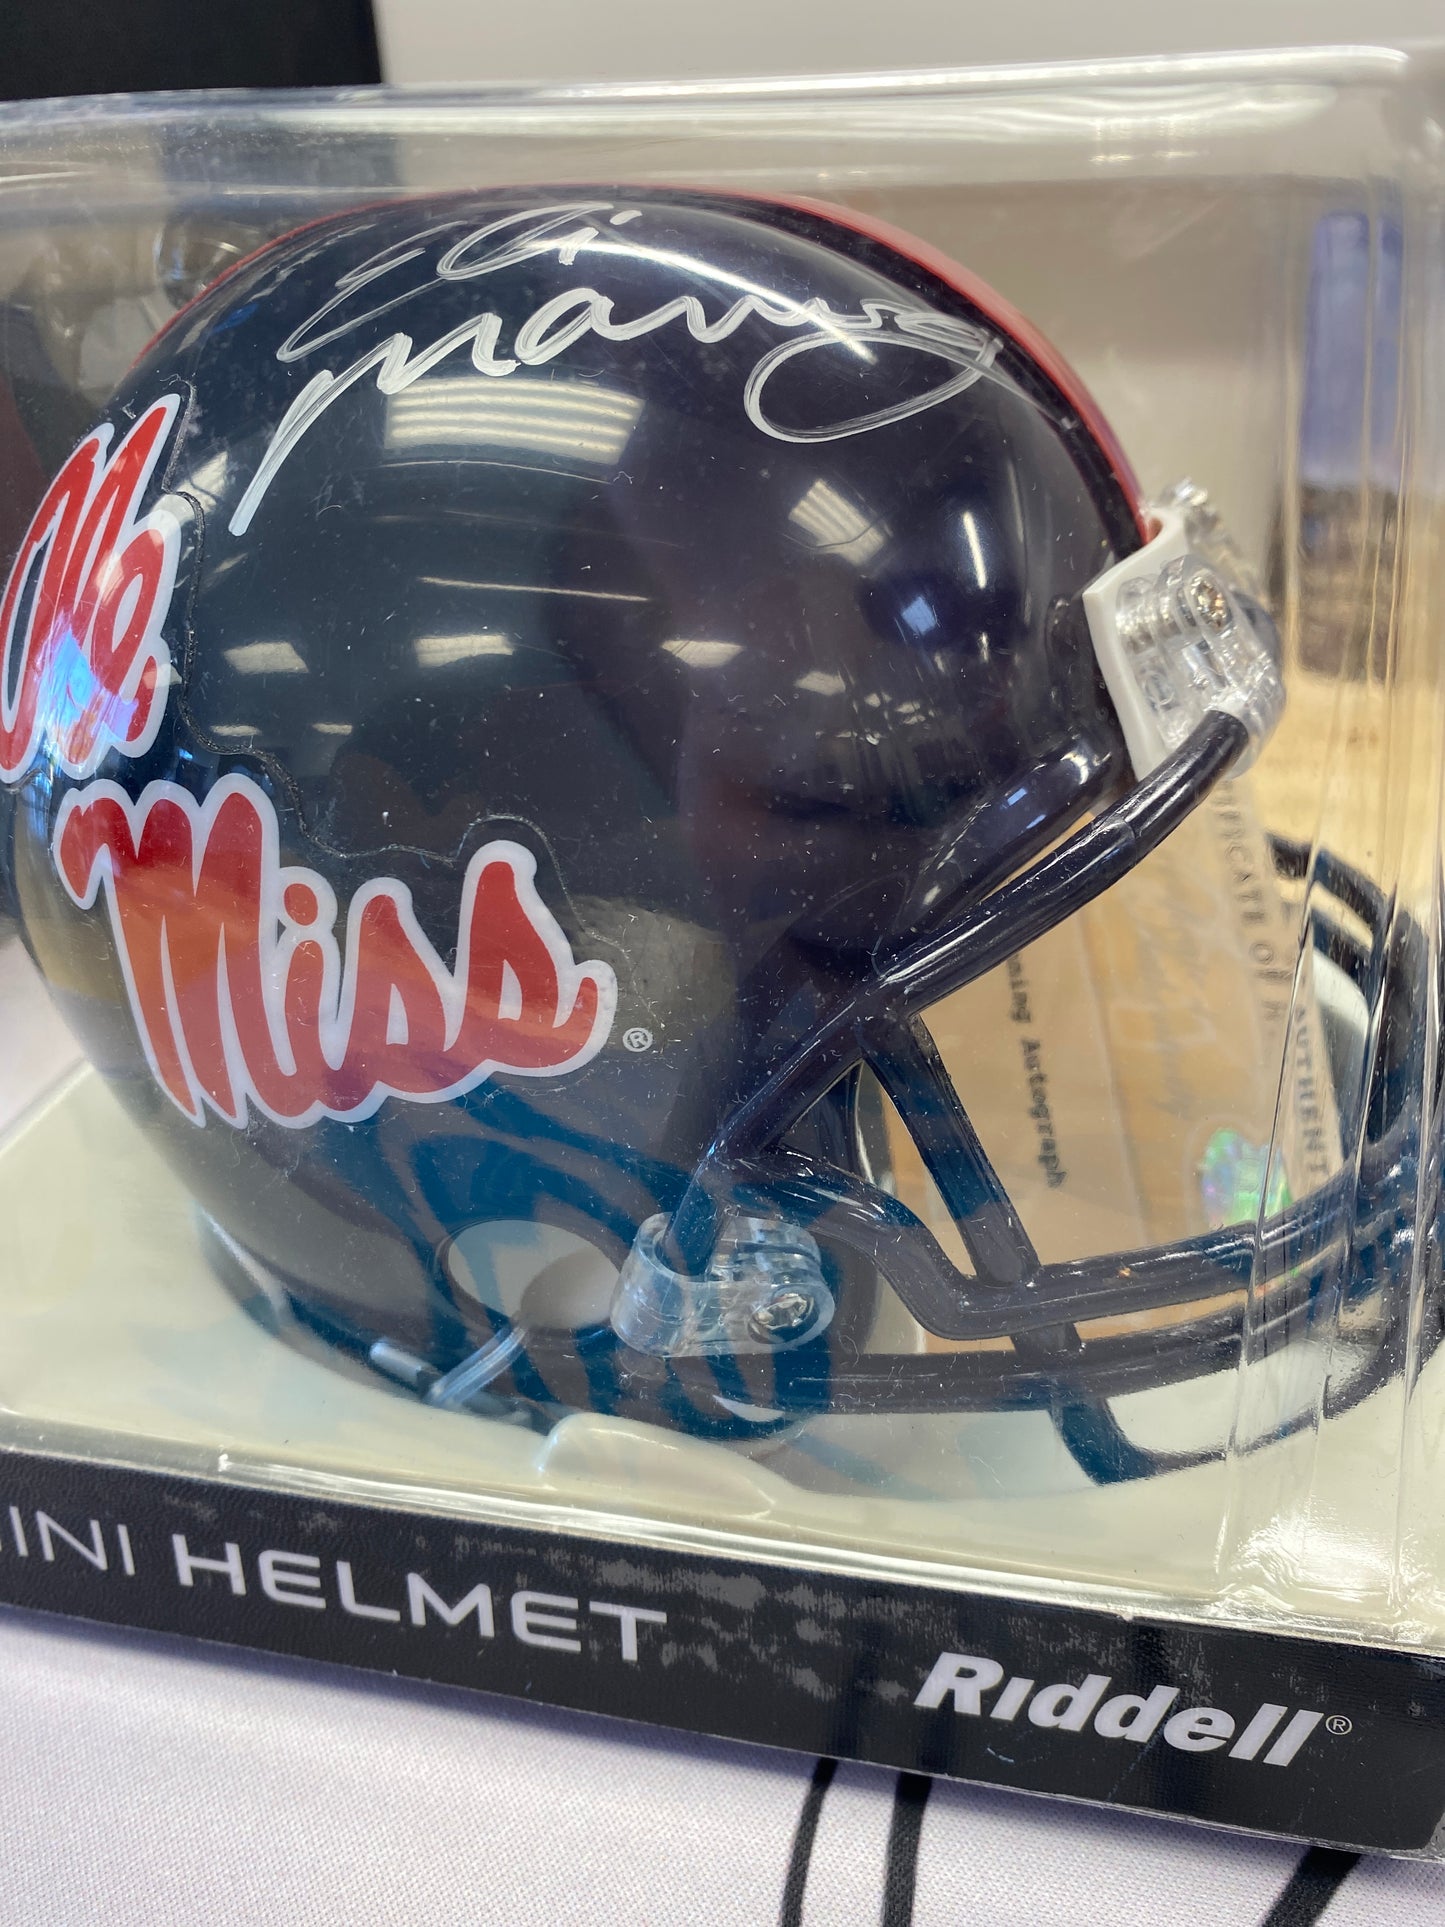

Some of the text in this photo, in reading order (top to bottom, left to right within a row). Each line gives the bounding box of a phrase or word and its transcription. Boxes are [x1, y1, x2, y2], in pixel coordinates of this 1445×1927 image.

[0, 393, 182, 783] Ole
[54, 772, 619, 1130] Miss
[1020, 1037, 1068, 1189] Autograph
[0, 1504, 668, 1663] INI HELMET
